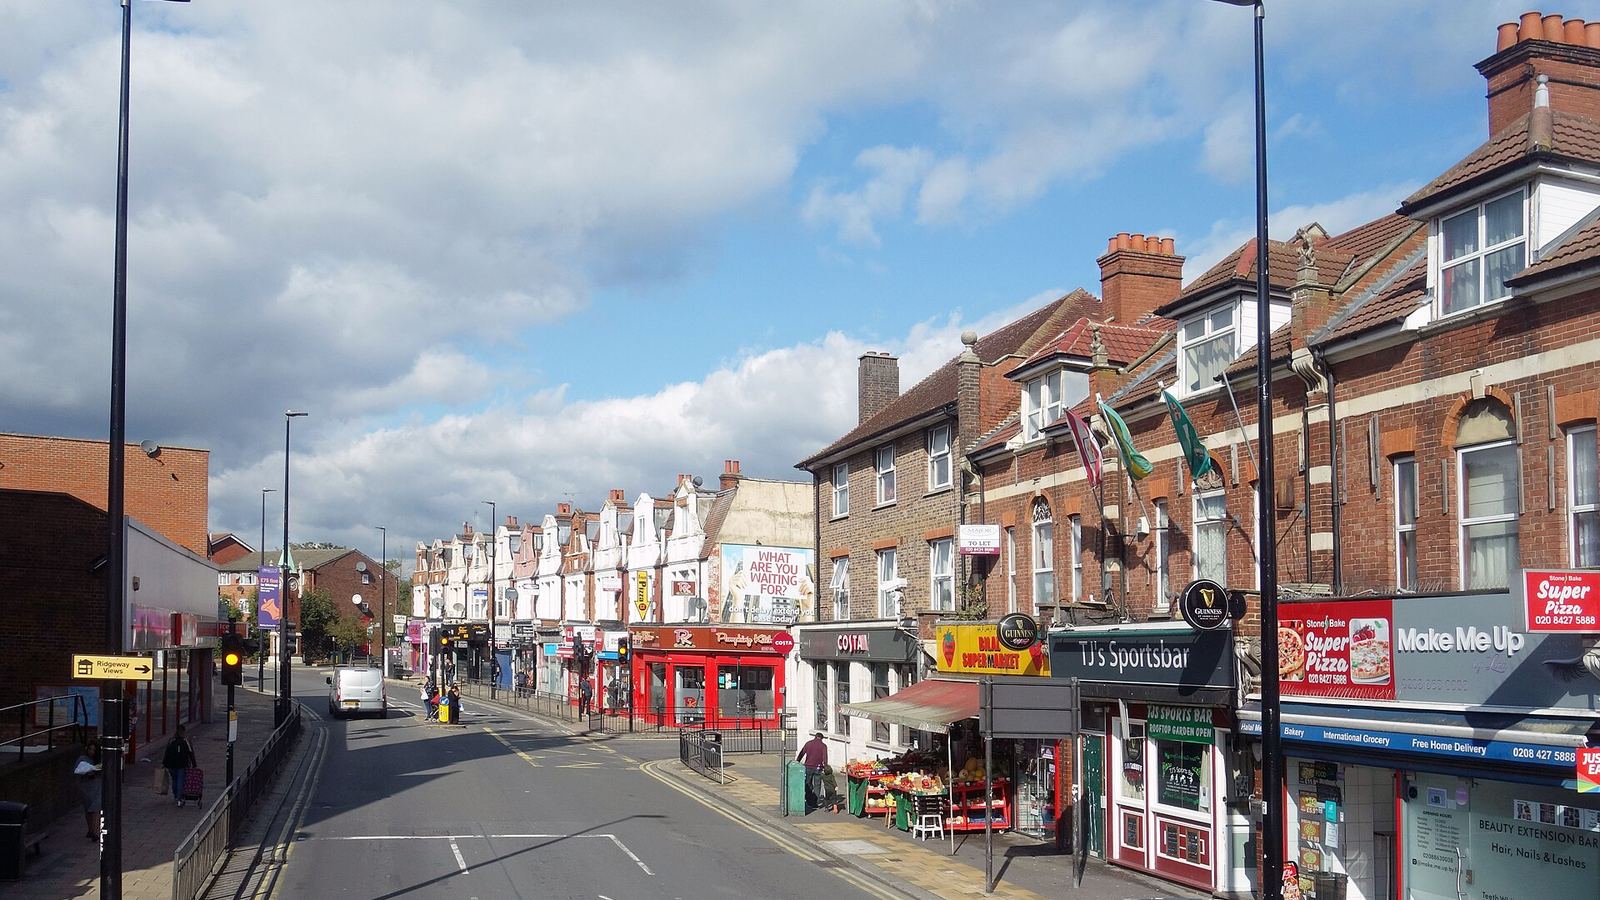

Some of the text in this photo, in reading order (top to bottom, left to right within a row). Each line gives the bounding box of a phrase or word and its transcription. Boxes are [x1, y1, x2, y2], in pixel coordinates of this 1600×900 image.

[758, 551, 791, 563] WHAT
[750, 562, 798, 575] ARE YOU
[750, 572, 797, 586] WAITING
[760, 584, 787, 596] FOR?
[1537, 580, 1590, 604] Super
[1545, 600, 1582, 615] Pizza
[772, 615, 796, 624] today!
[1306, 619, 1346, 628] Stone Bake
[1535, 616, 1595, 624] 020 8427 5888
[1005, 629, 1034, 638] GUINNESS
[1398, 625, 1525, 657] Make Me Up
[837, 634, 869, 652] COSTA
[1305, 632, 1349, 657] Super
[962, 653, 1019, 669] SUPERMARKET
[1079, 639, 1190, 674] TJ's Sportsbar
[1306, 652, 1348, 672] Pizza
[1308, 674, 1347, 684] 020 8427 5888
[1147, 705, 1212, 724] TJS SPORTS BAR
[1150, 724, 1212, 737] ROOFTOP GARDEN OPEN
[1240, 723, 1254, 731] Halal
[1284, 727, 1304, 738] Bakery
[1323, 730, 1362, 742] International
[1363, 734, 1390, 746] Grocery
[1412, 738, 1429, 749] Free
[1430, 740, 1452, 751] Home
[1454, 742, 1487, 756] Delivery
[1513, 747, 1534, 758] 0208
[1536, 749, 1551, 760] 427
[1554, 751, 1576, 762] 5888
[1479, 819, 1599, 849] BEAUTY EXTENSION BAR
[1492, 842, 1586, 869] Hair, Nails & Lashes
